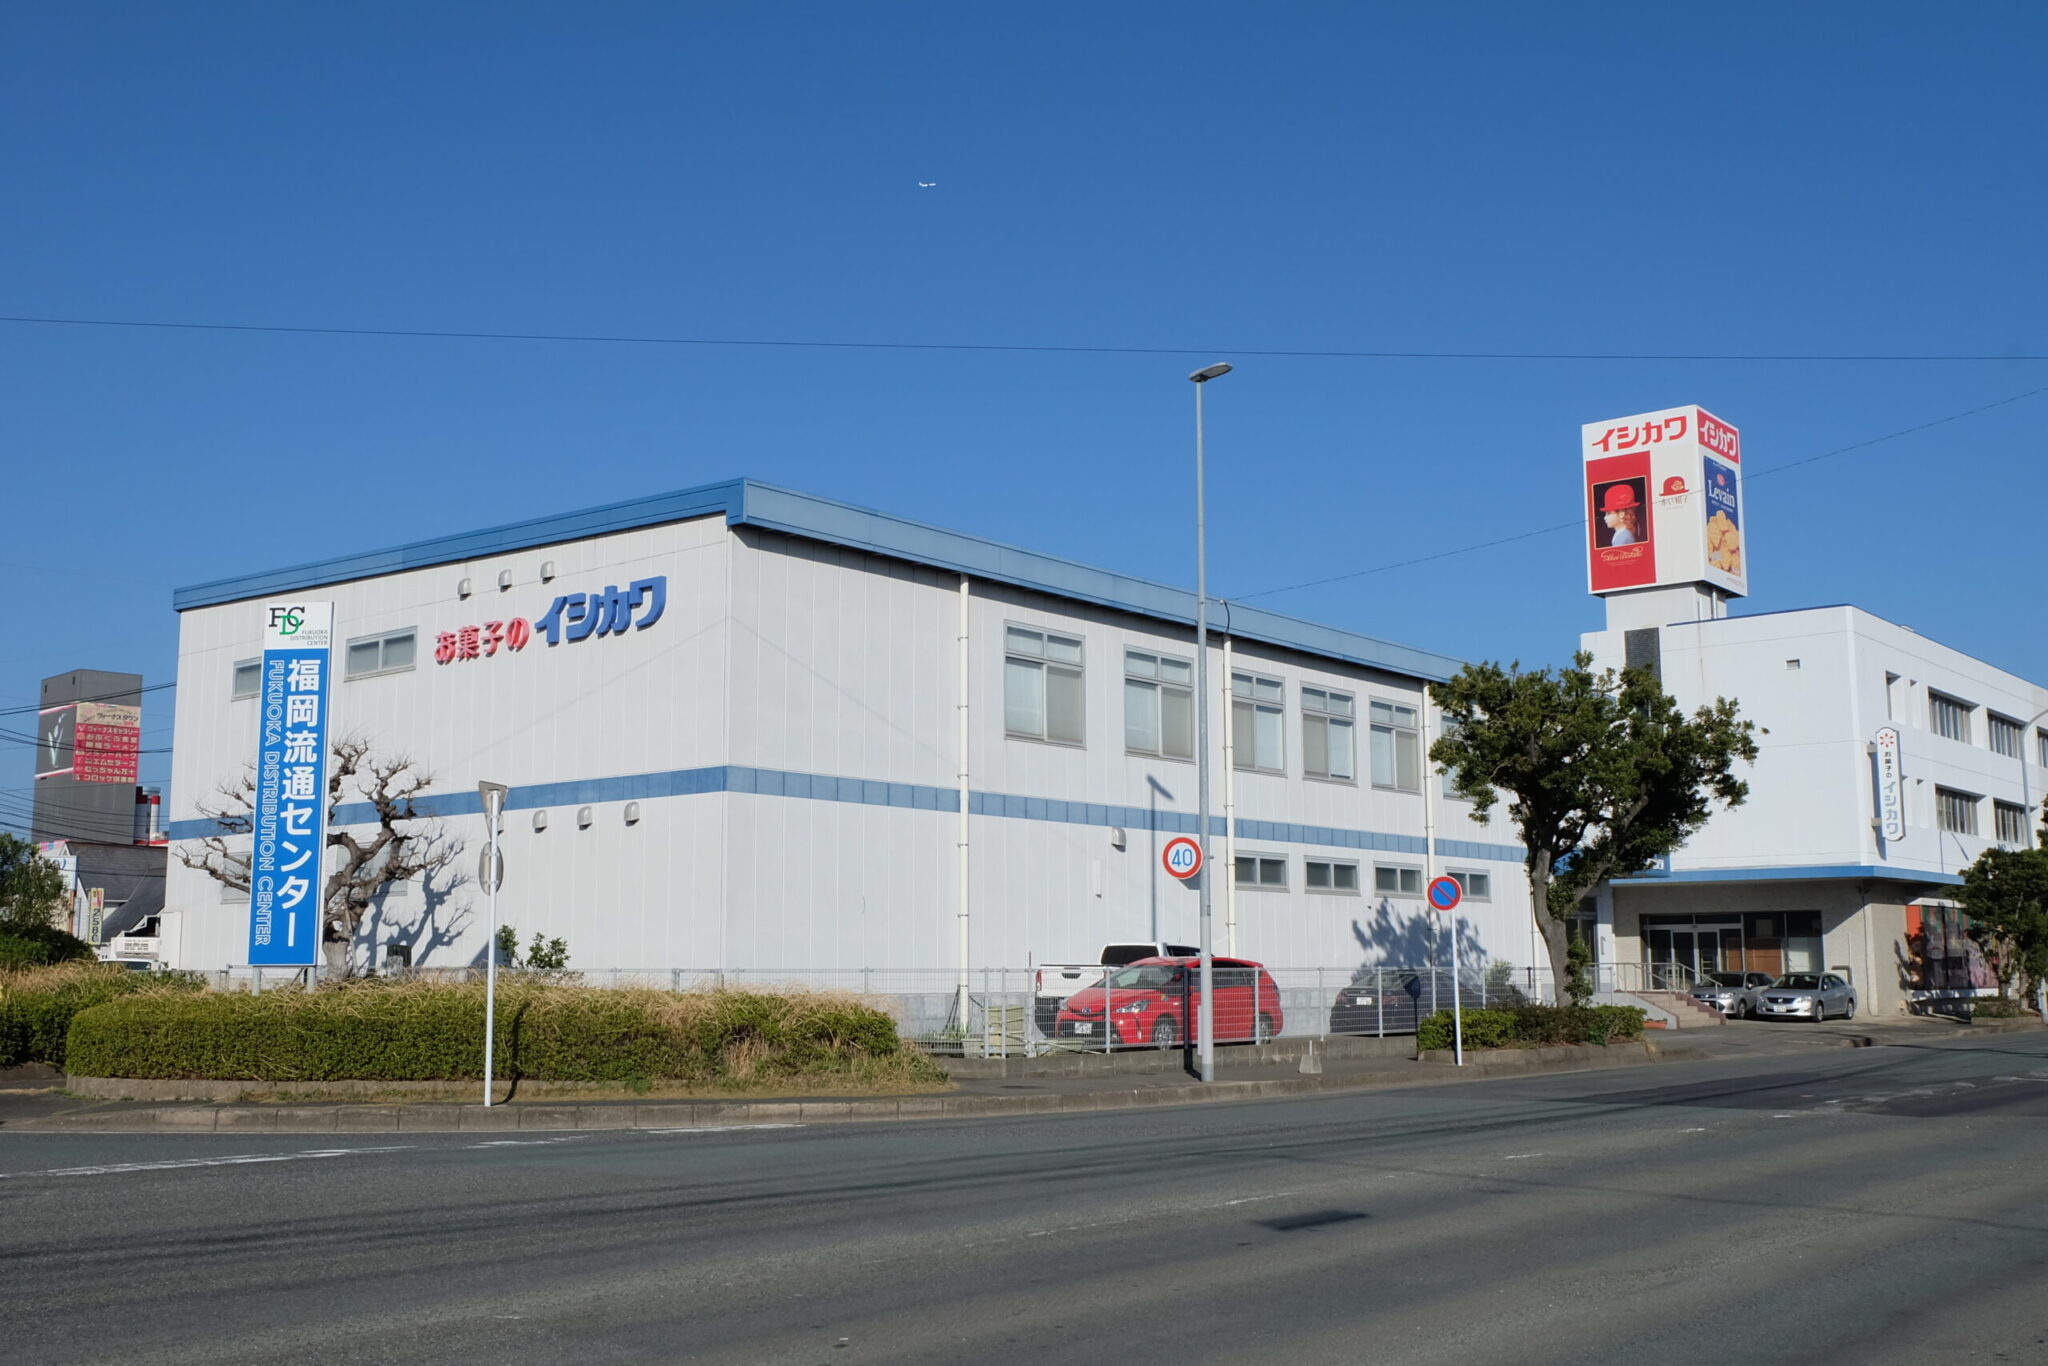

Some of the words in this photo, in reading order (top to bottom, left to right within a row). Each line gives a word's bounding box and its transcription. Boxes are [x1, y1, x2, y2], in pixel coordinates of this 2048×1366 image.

[1592, 415, 1687, 452] イシカワ
[1700, 420, 1737, 457] イシカワ
[1708, 479, 1735, 508] Levain
[434, 617, 530, 663] お菓子の
[534, 576, 667, 644] イシカワ
[265, 660, 285, 747] FUKUOKA
[259, 751, 280, 871] DISTRIBUTION
[276, 658, 321, 947] 福岡流通センター
[1884, 781, 1899, 835] イシカワ
[1171, 848, 1193, 867] 40
[254, 875, 274, 946] CENTER
